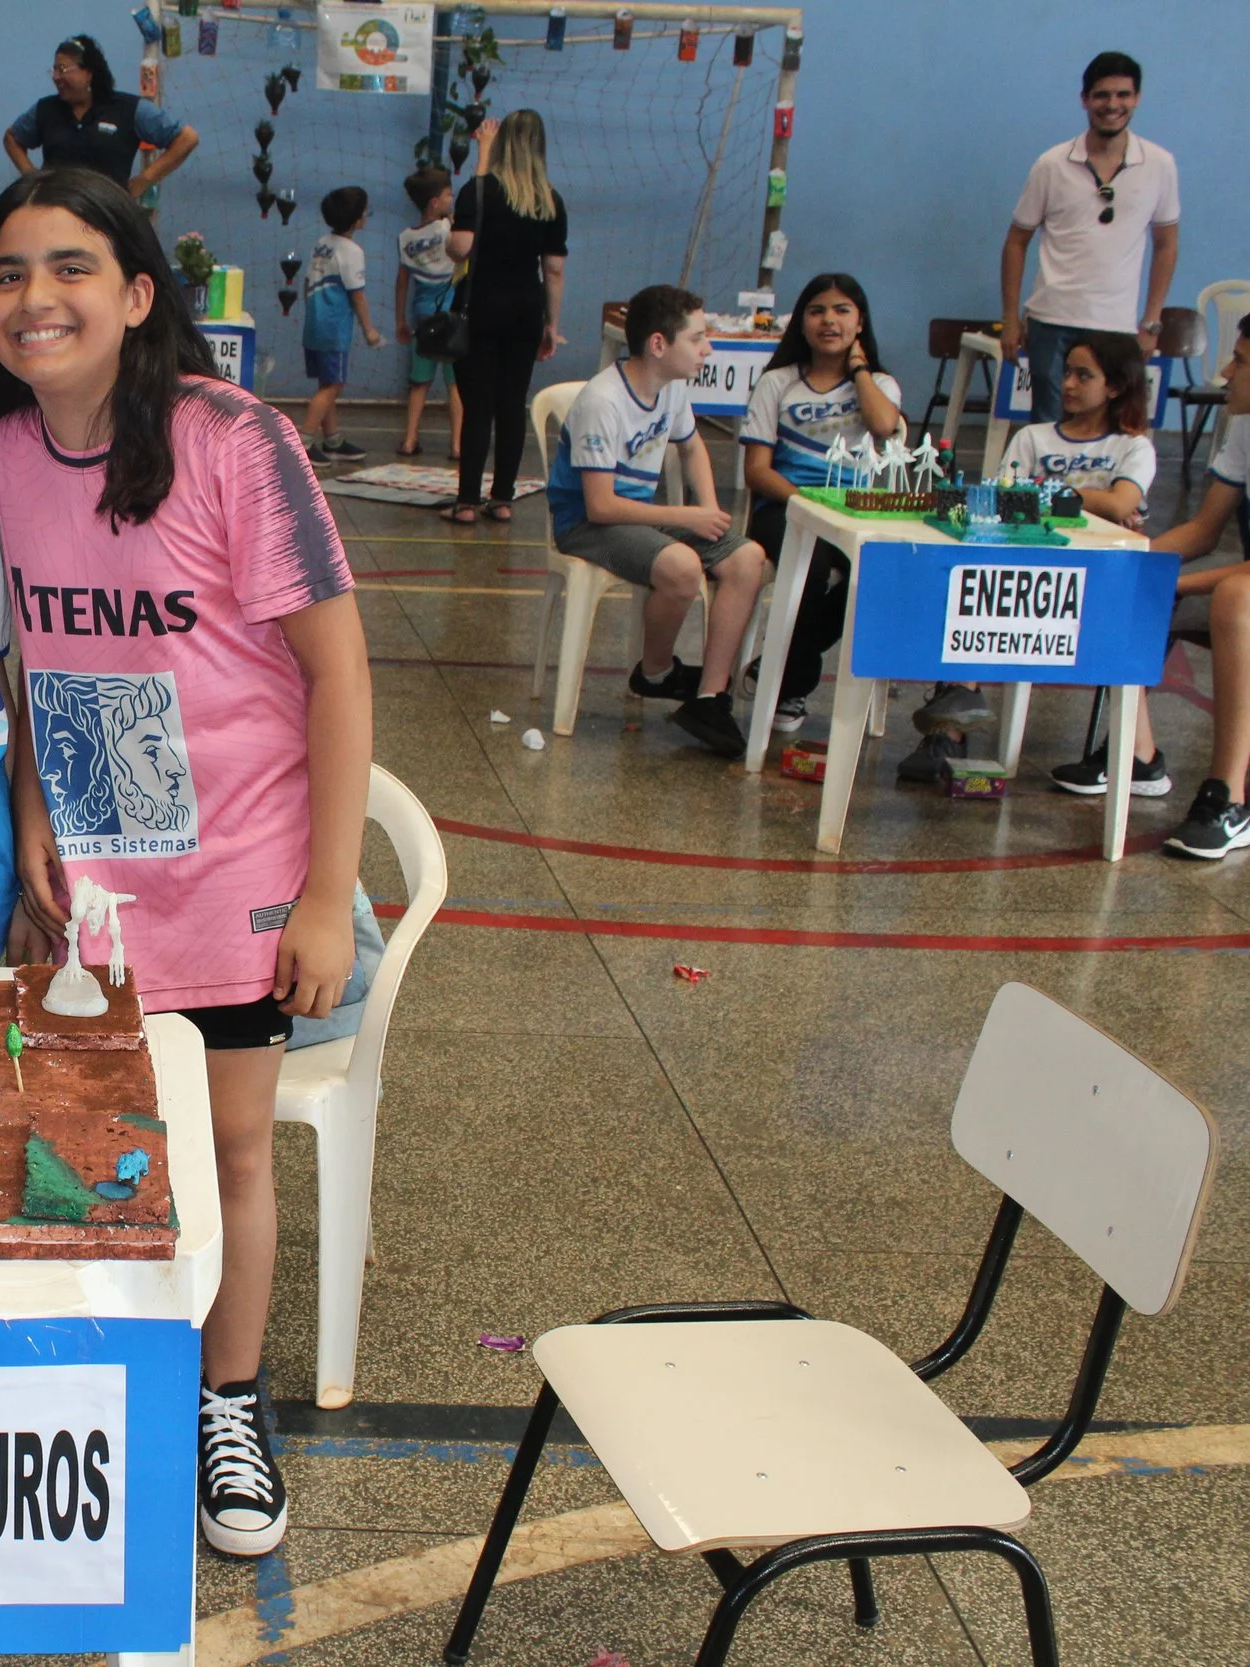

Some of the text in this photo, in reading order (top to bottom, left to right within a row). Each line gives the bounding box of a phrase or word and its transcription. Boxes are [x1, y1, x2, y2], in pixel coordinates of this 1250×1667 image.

[221, 342, 237, 357] DE
[726, 365, 735, 391] O
[958, 569, 1079, 619] ENERGIA
[950, 629, 1075, 656] SUSTENTÁVEL
[57, 837, 196, 857] anus Sistemas
